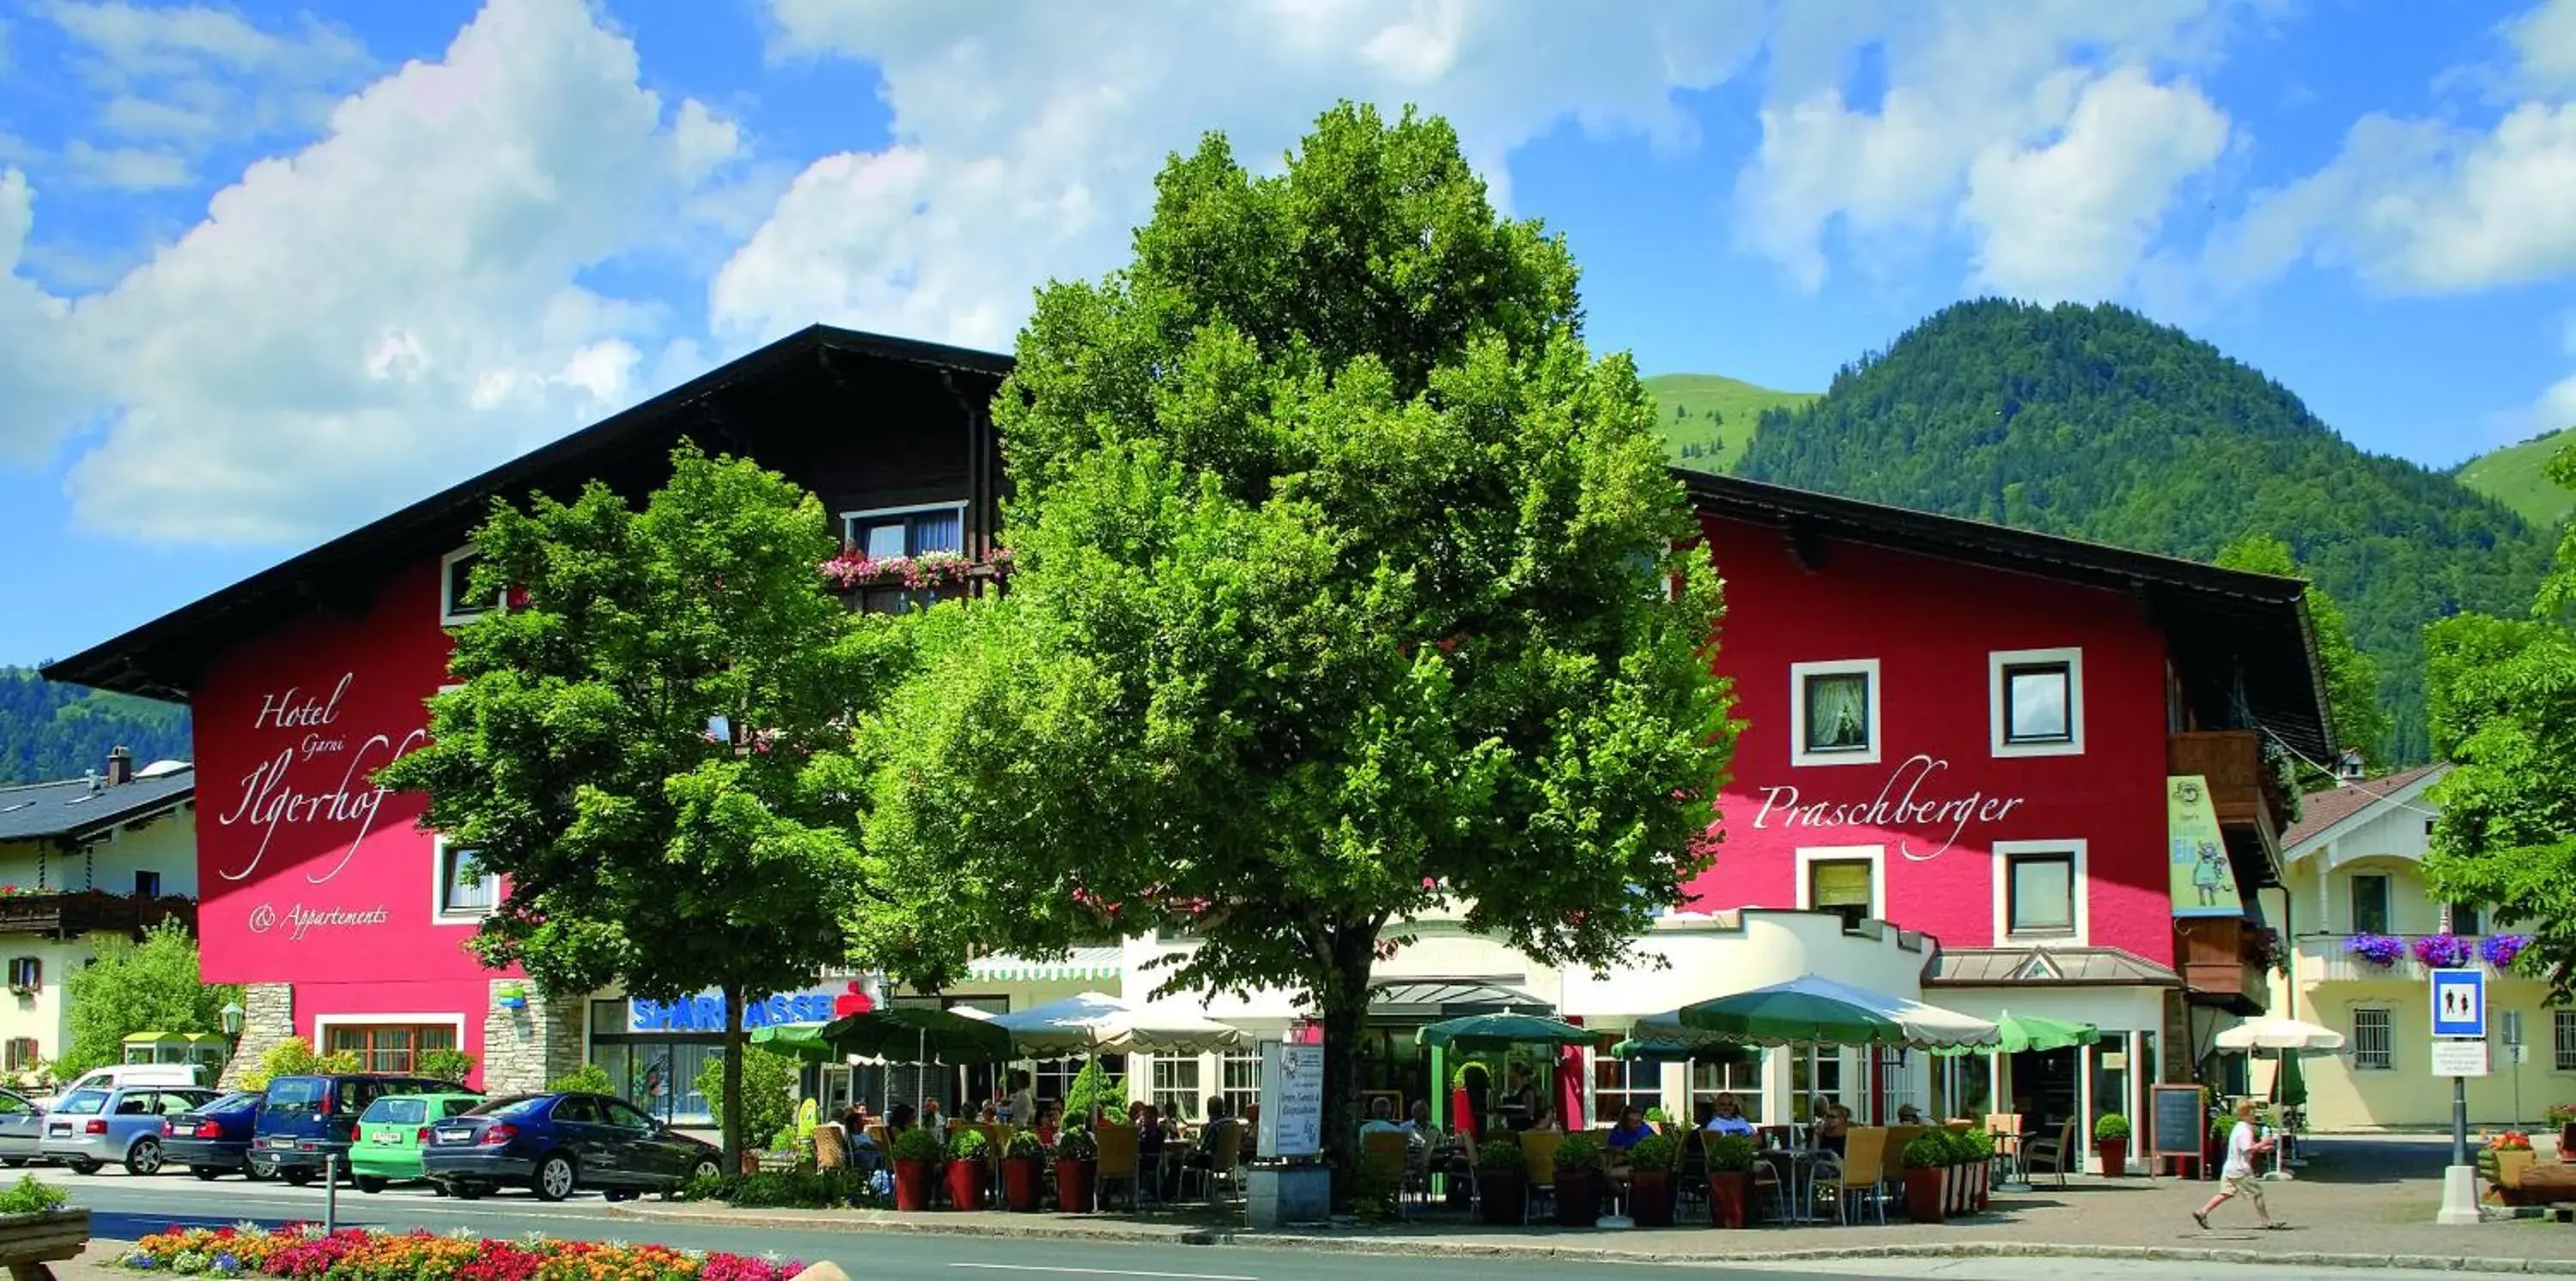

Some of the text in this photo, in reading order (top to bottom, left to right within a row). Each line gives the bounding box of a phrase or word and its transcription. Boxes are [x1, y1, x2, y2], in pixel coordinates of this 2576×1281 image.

[254, 672, 353, 728] Hotel
[301, 732, 344, 761] Garni
[219, 729, 425, 883] Ilgerhof
[1753, 754, 2024, 861] Praschberger
[280, 902, 389, 940] Appartements
